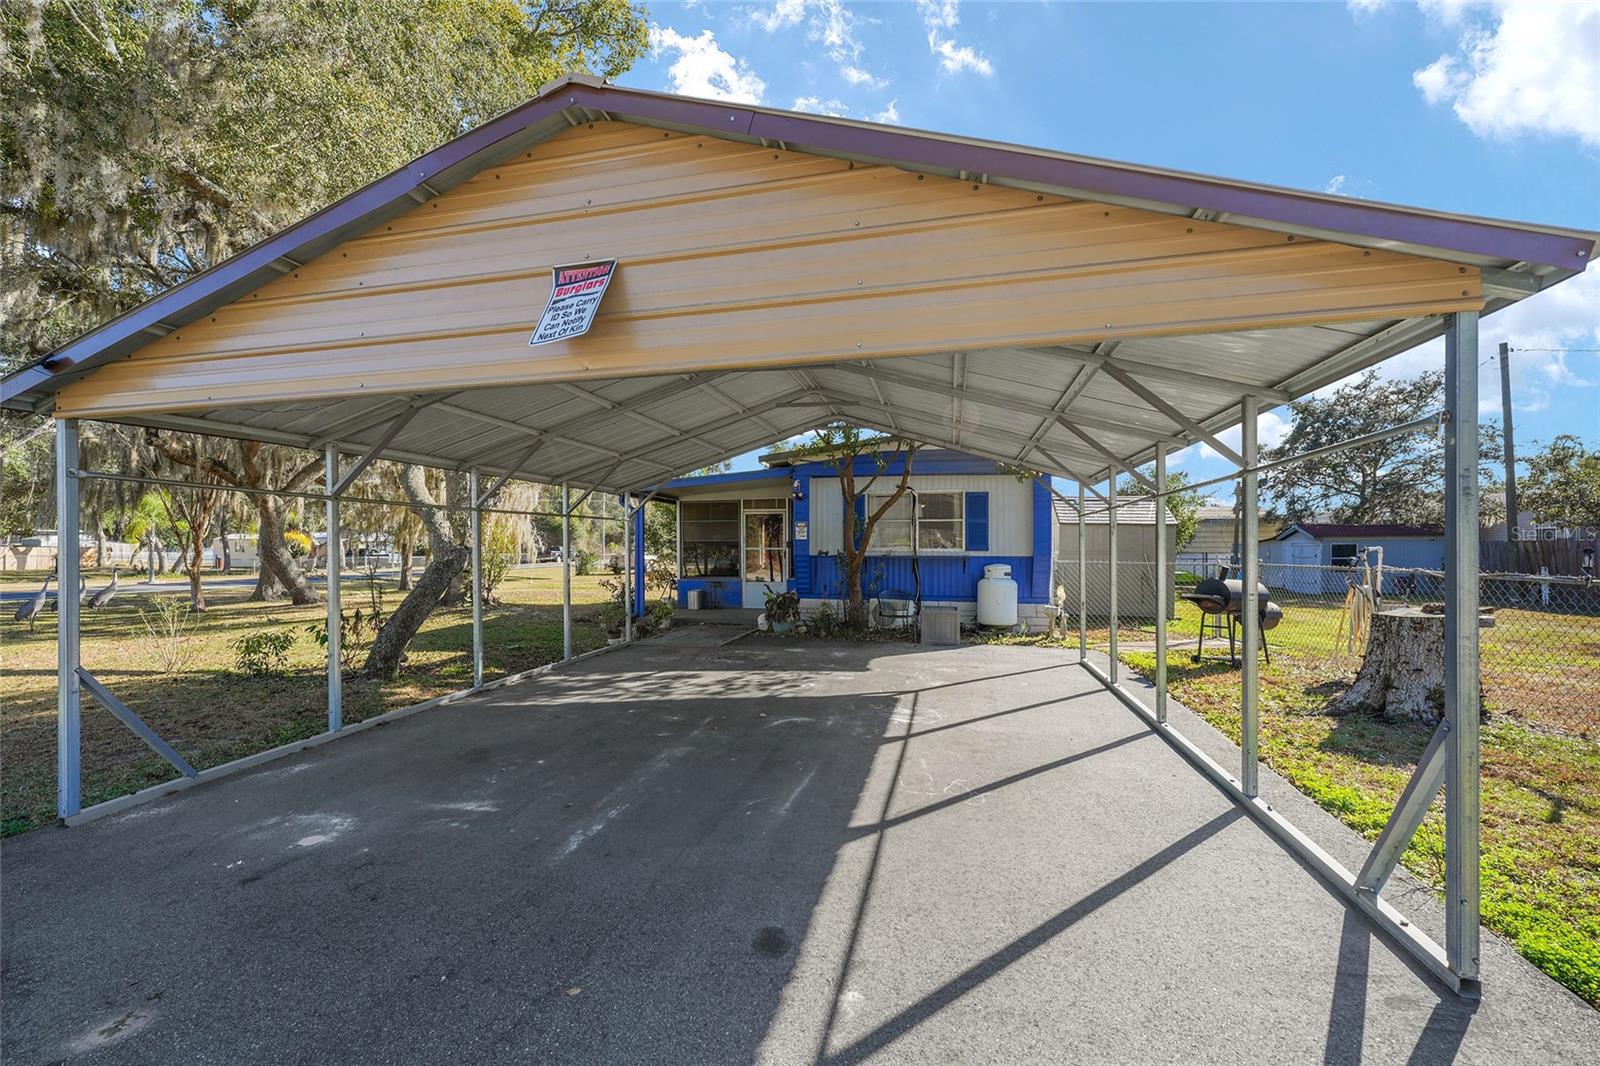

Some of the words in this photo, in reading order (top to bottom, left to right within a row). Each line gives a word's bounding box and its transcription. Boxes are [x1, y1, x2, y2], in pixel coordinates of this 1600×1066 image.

[558, 265, 612, 284] ATTENTION
[555, 278, 606, 297] Burglars
[547, 303, 574, 314] Please
[576, 296, 598, 307] Carry
[550, 313, 560, 321] ID
[561, 311, 572, 319] So
[574, 307, 587, 315] We
[544, 323, 560, 331] Can
[561, 316, 586, 327] Notify
[537, 331, 556, 341] Next
[559, 327, 569, 335] Of
[570, 324, 583, 332] Kin
